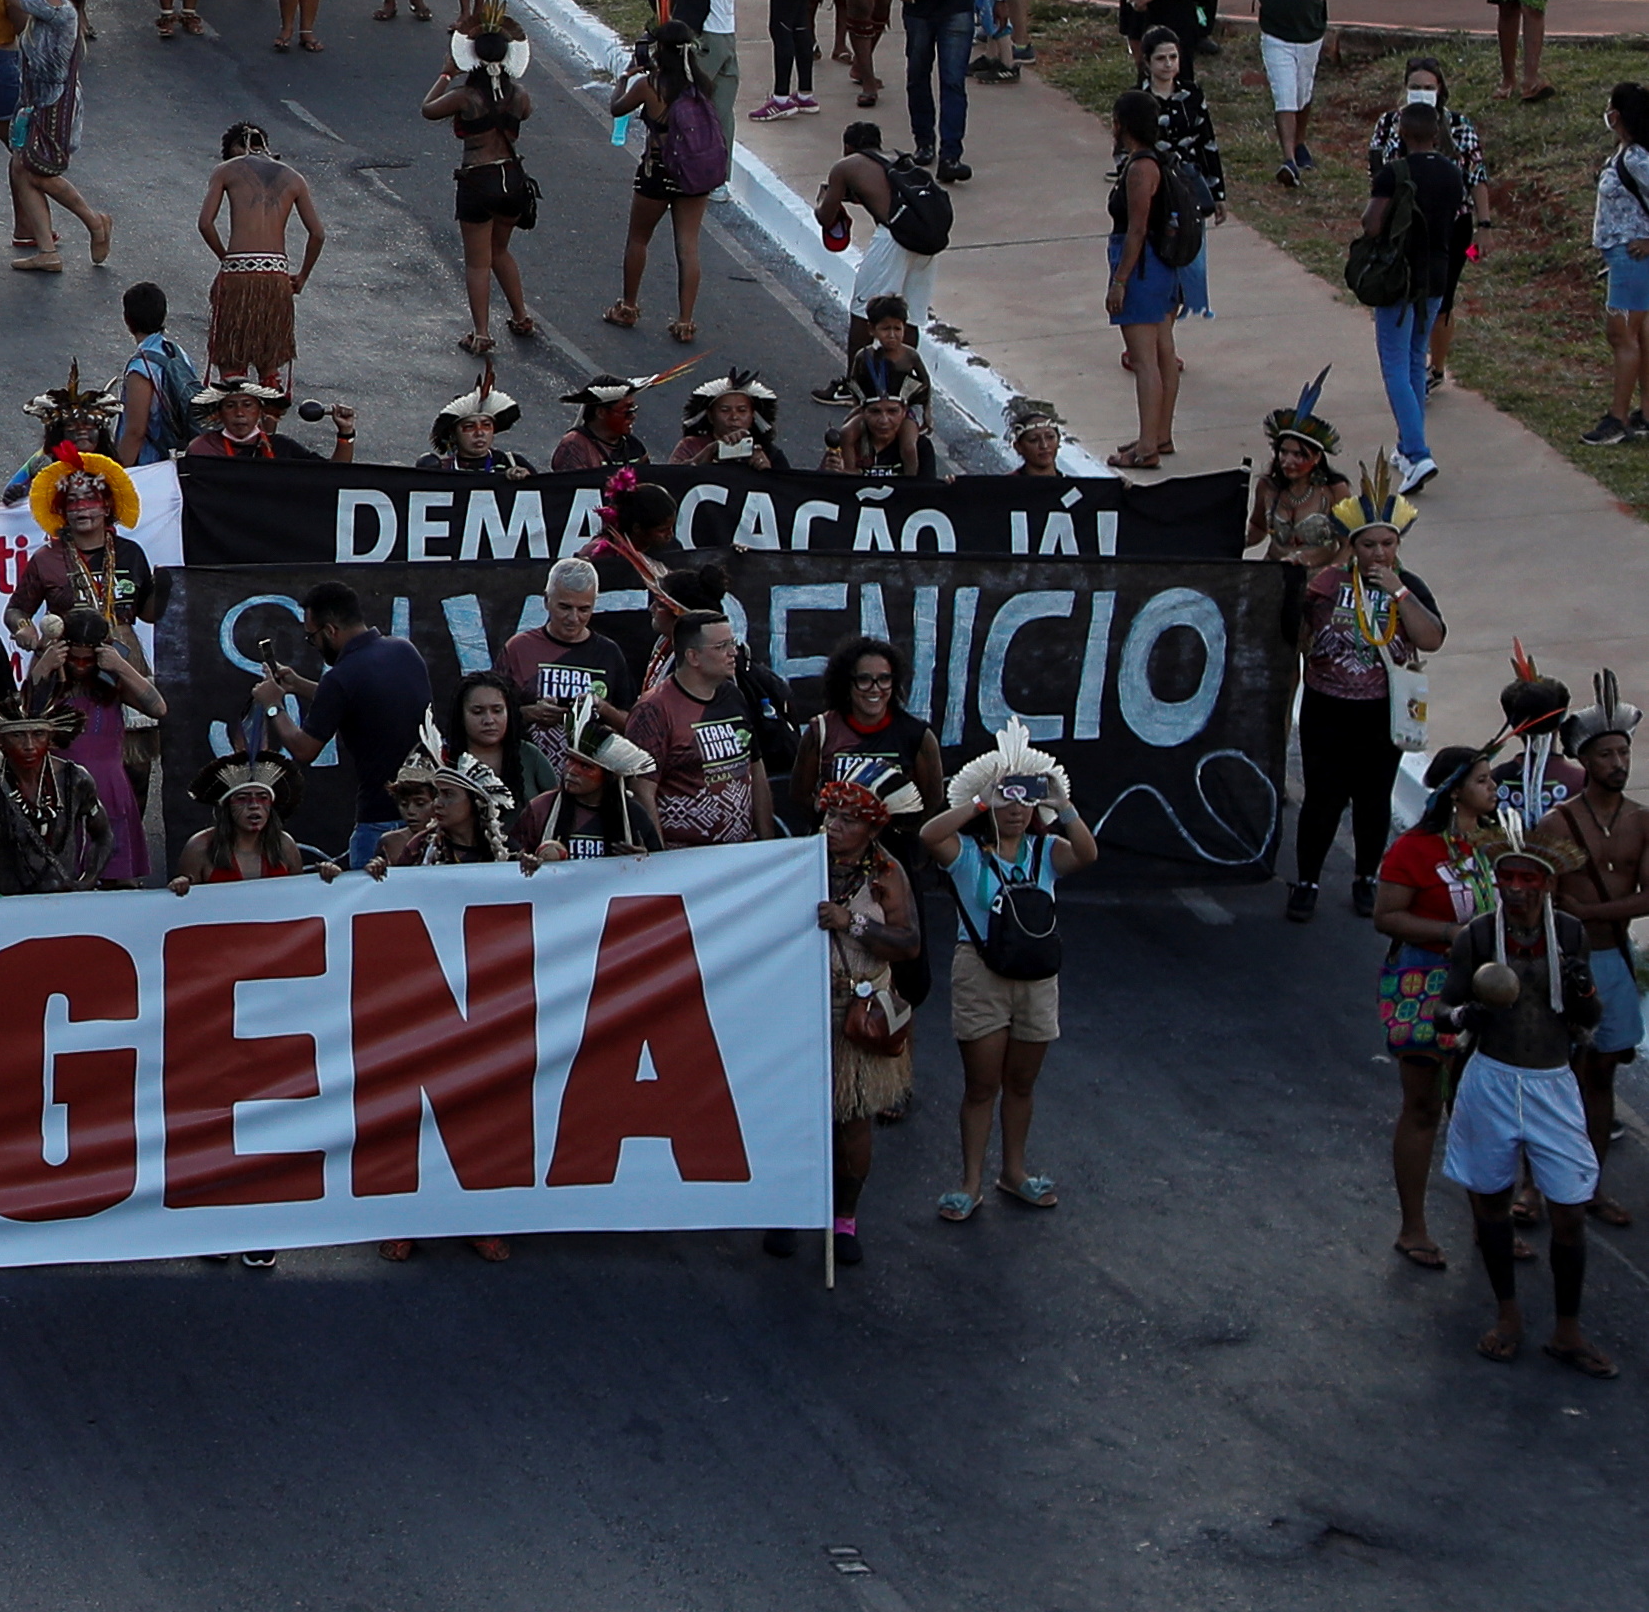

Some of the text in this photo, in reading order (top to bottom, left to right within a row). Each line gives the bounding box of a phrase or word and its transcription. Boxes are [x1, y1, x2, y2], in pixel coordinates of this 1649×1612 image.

[335, 482, 957, 564] DEMACAÇÃO
[542, 667, 592, 685] TERRA
[696, 723, 737, 743] TERRA
[702, 738, 744, 762] LIVRE
[568, 838, 605, 856] TERR
